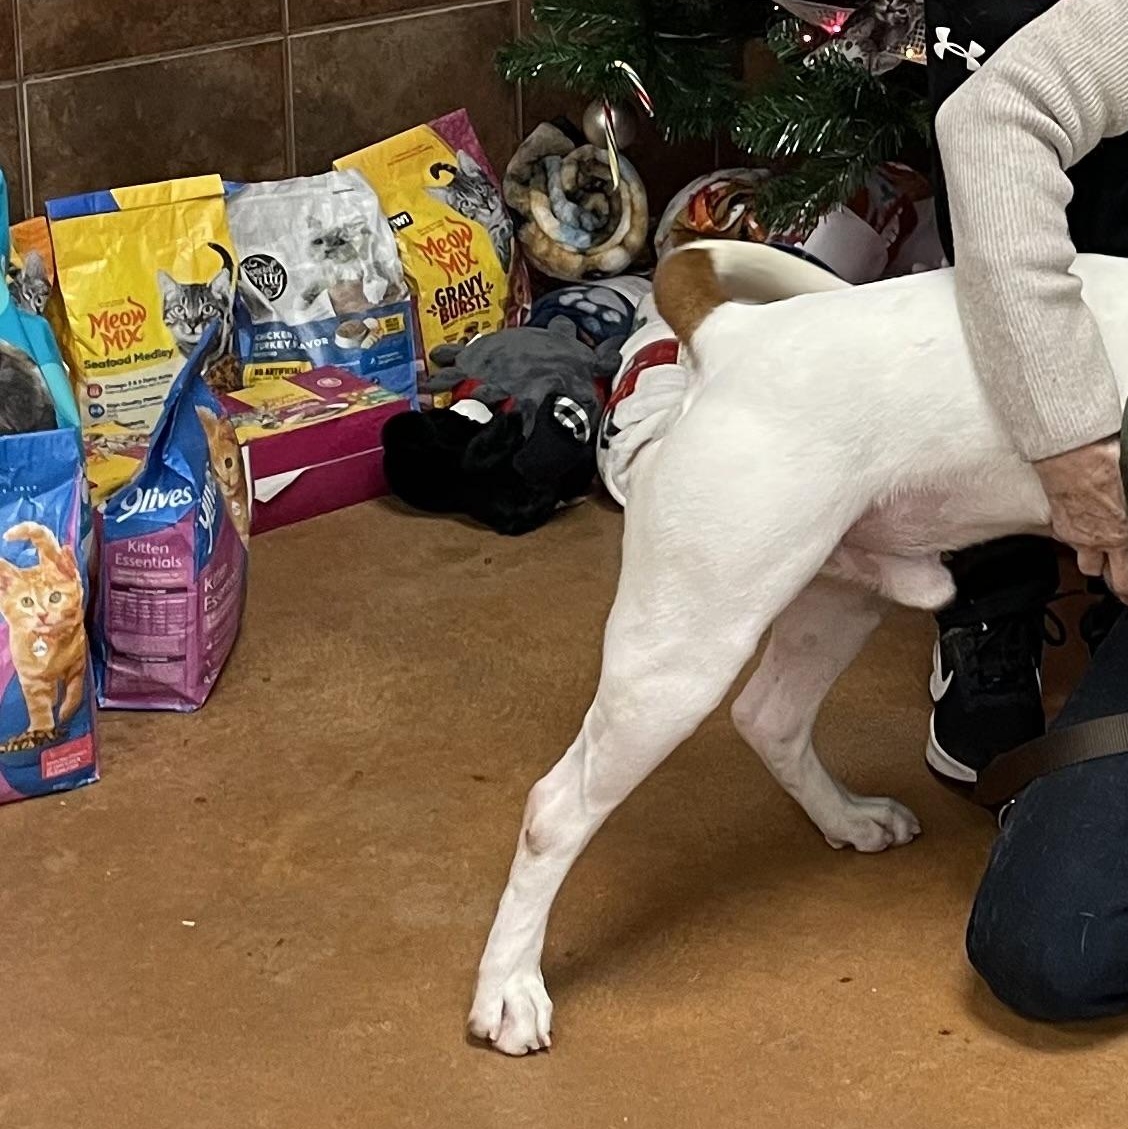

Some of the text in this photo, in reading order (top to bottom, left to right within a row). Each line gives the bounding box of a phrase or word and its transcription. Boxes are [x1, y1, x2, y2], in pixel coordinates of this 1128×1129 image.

[415, 216, 473, 266] Meow
[434, 272, 486, 308] GRAVY
[88, 296, 147, 339] Meow
[438, 293, 490, 325] BURSTS
[84, 349, 174, 369] Seafood Medley
[116, 486, 193, 523] 9Lives
[115, 553, 182, 569] Essentials
[128, 541, 169, 554] Kitten
